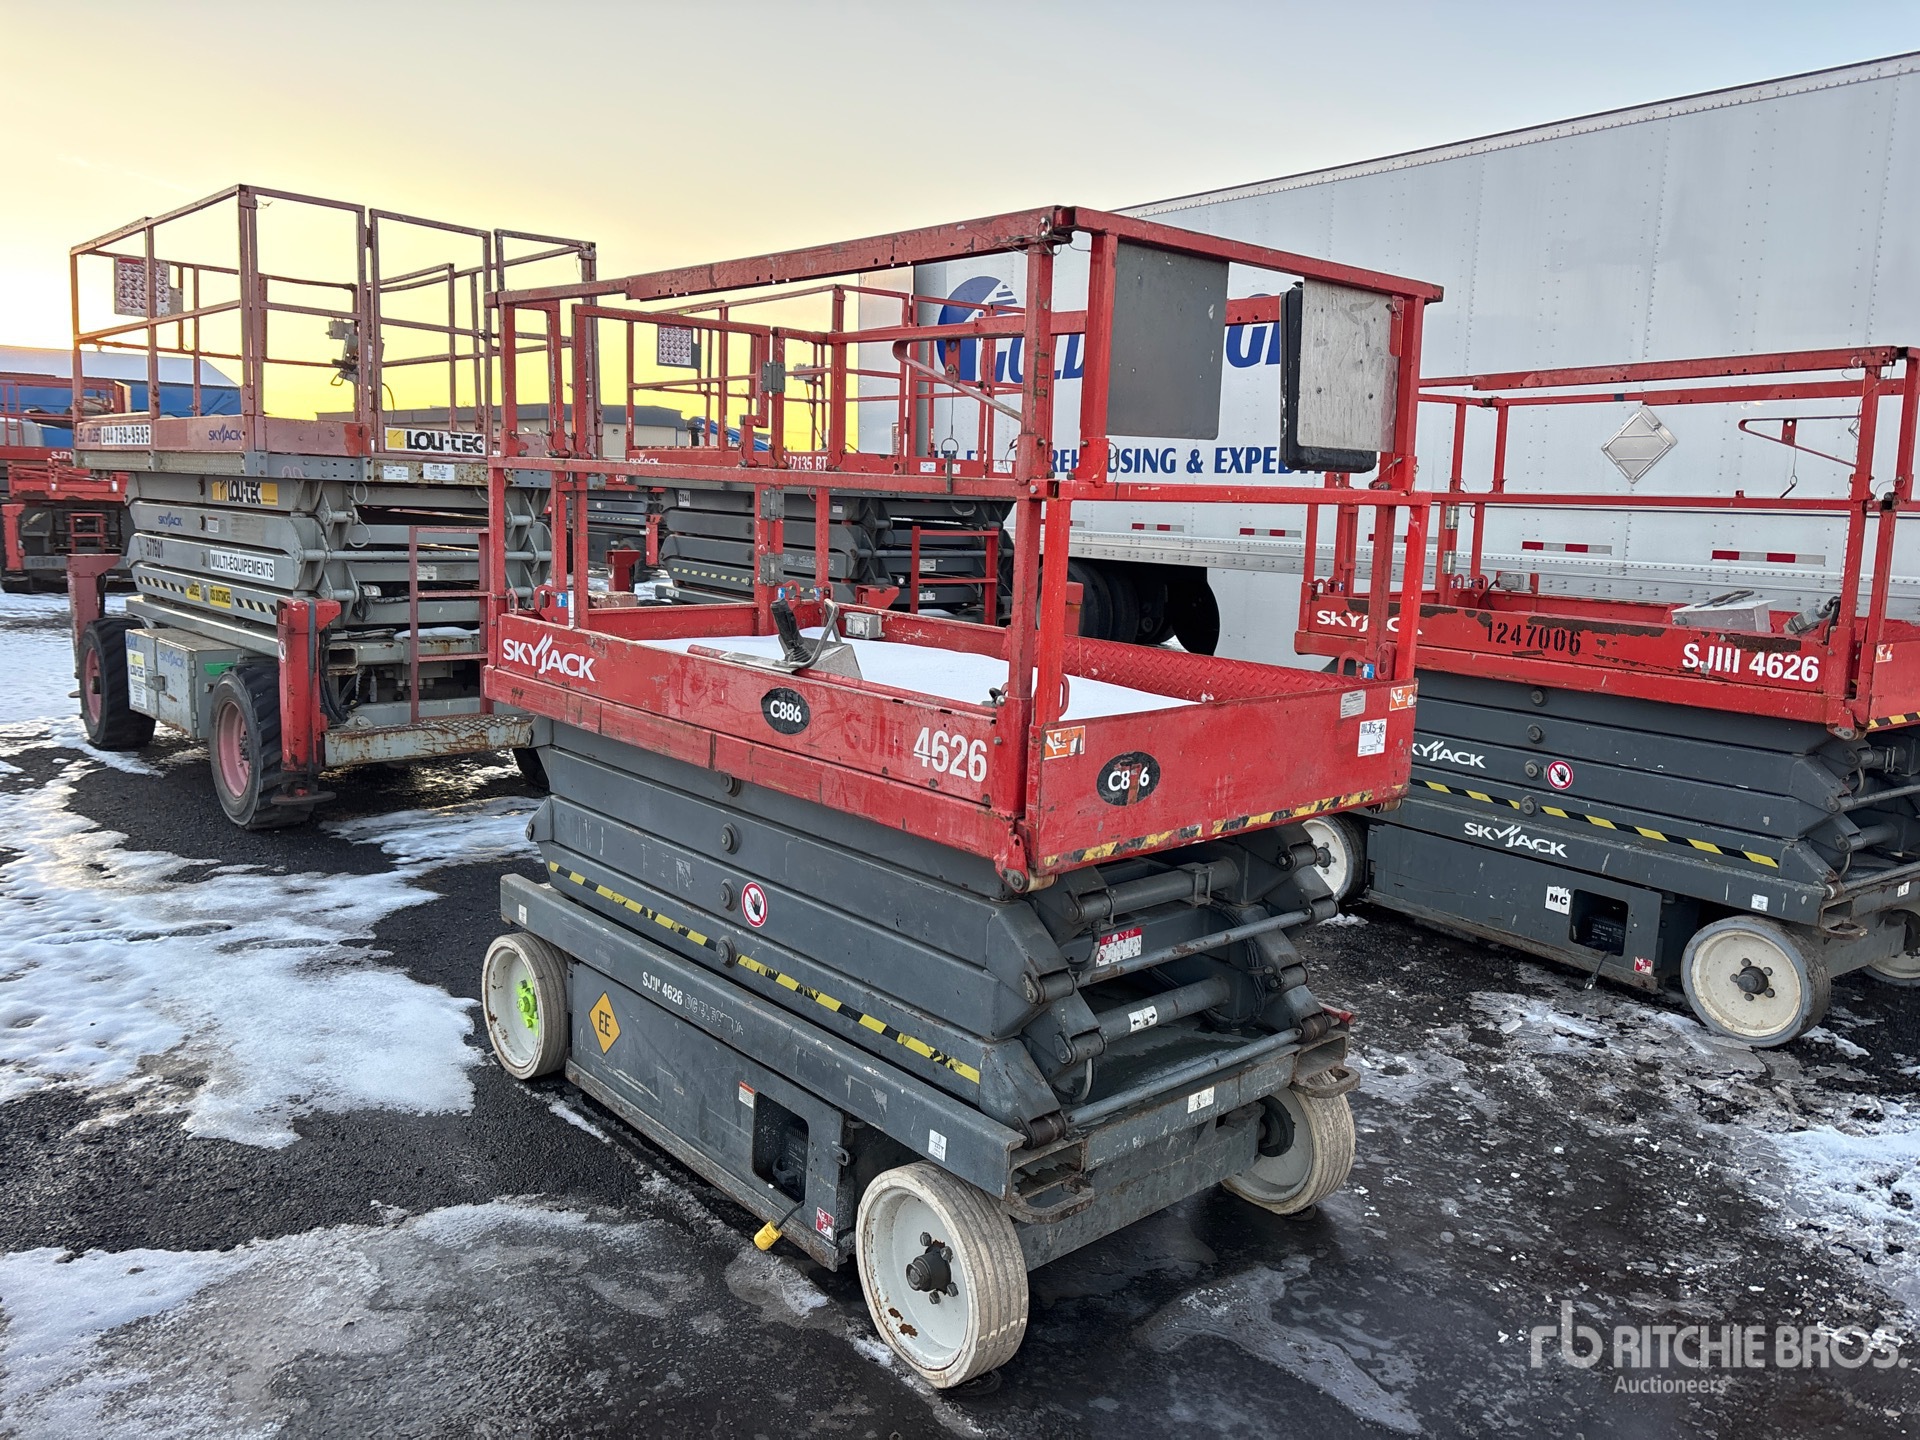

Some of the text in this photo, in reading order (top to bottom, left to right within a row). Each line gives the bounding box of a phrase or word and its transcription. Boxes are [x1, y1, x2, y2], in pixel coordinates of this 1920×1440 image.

[115, 426, 150, 443] 759-9595
[208, 424, 242, 443] SKYJACK
[406, 430, 484, 454] LOU-TEC
[1186, 448, 1204, 473] &
[227, 480, 261, 504] LOU-TEC
[158, 512, 183, 527] SKYJACK
[211, 553, 274, 578] MULTI-ÉQUIPEMENTS
[1316, 610, 1422, 635] SKYJC
[1487, 621, 1582, 652] 1247006
[503, 633, 596, 682] SKYJACK
[1749, 651, 1819, 683] 4626
[769, 700, 802, 723] C886
[913, 727, 988, 783] 4626
[1412, 741, 1486, 769] KYJACK
[1107, 766, 1150, 791] C86
[1463, 822, 1568, 858] SKYJACK
[1549, 893, 1568, 906] MC
[662, 983, 683, 1005] 4626
[598, 1010, 611, 1038] EE
